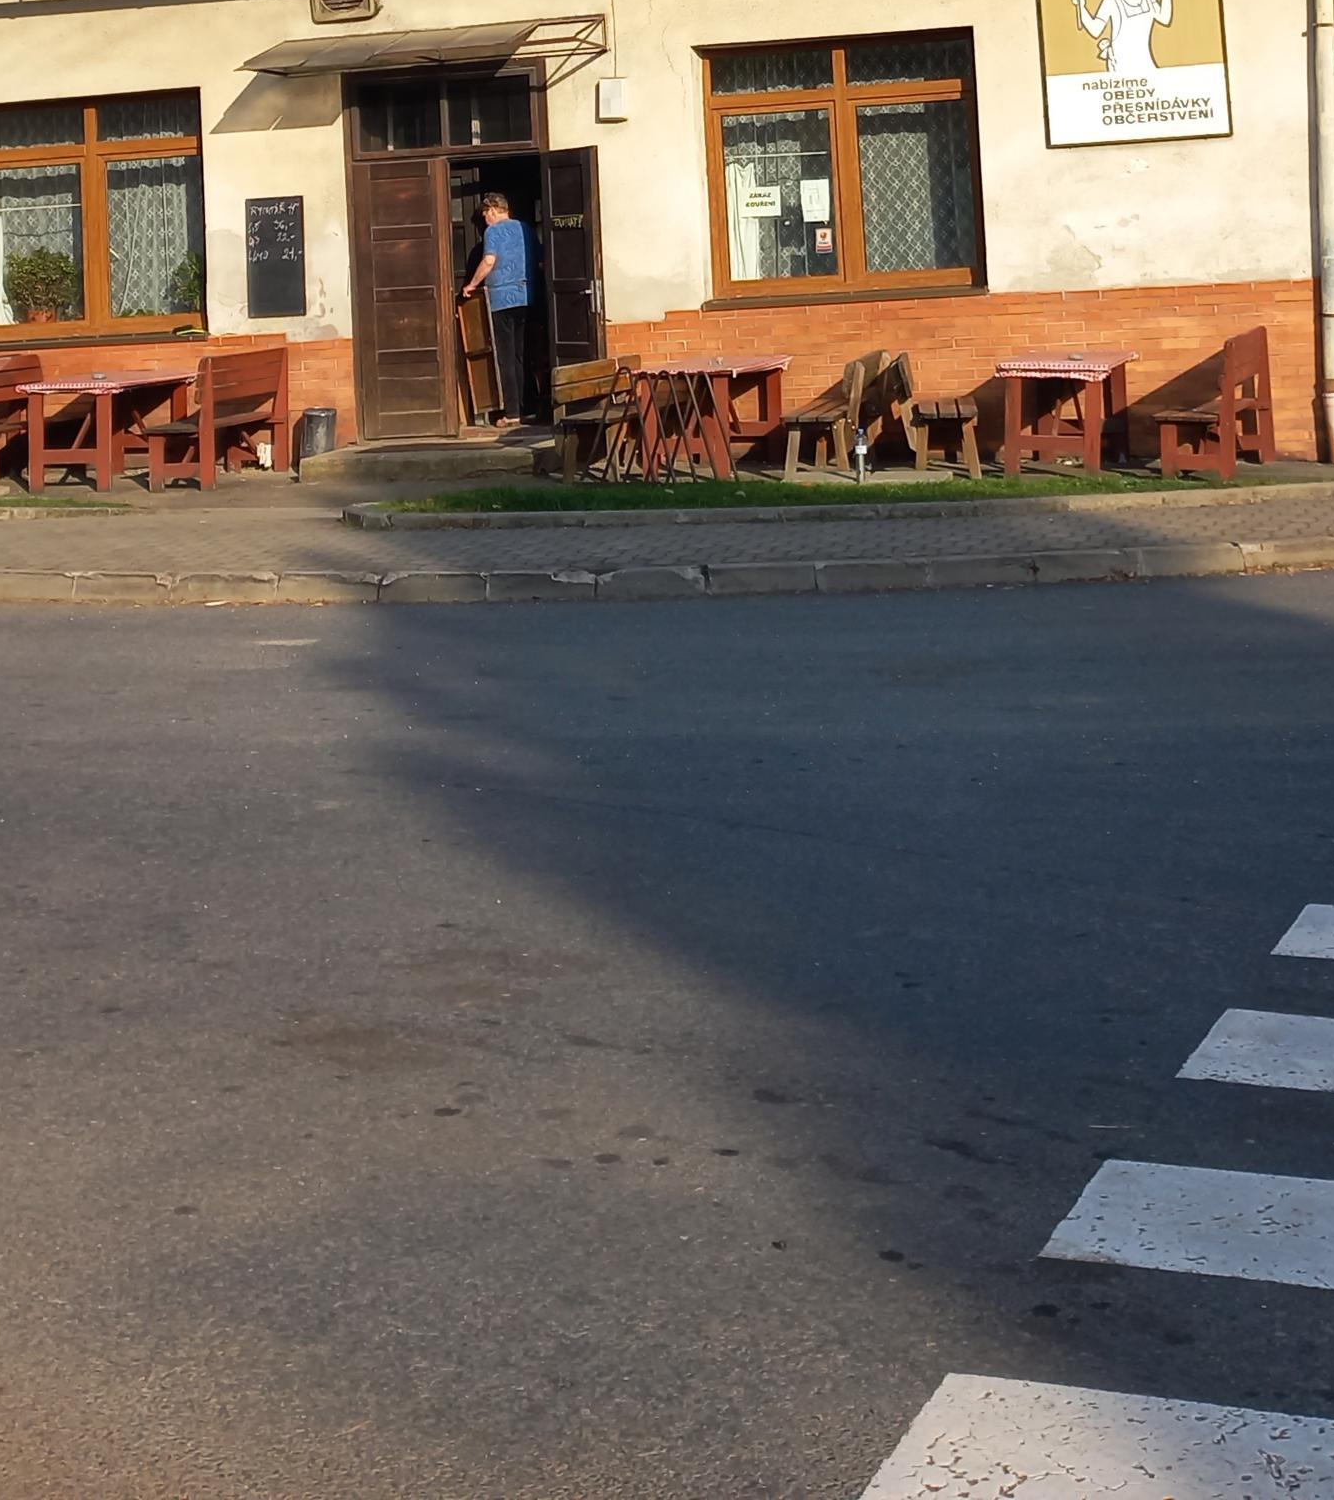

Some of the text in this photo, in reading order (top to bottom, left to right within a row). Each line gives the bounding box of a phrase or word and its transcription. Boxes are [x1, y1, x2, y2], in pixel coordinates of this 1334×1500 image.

[1082, 77, 1148, 91] nabízíme
[1102, 88, 1156, 101] OBĚDY
[1102, 97, 1211, 114] PŘESNÍDÁVKY
[1102, 108, 1214, 125] OBČERSTVENÍ
